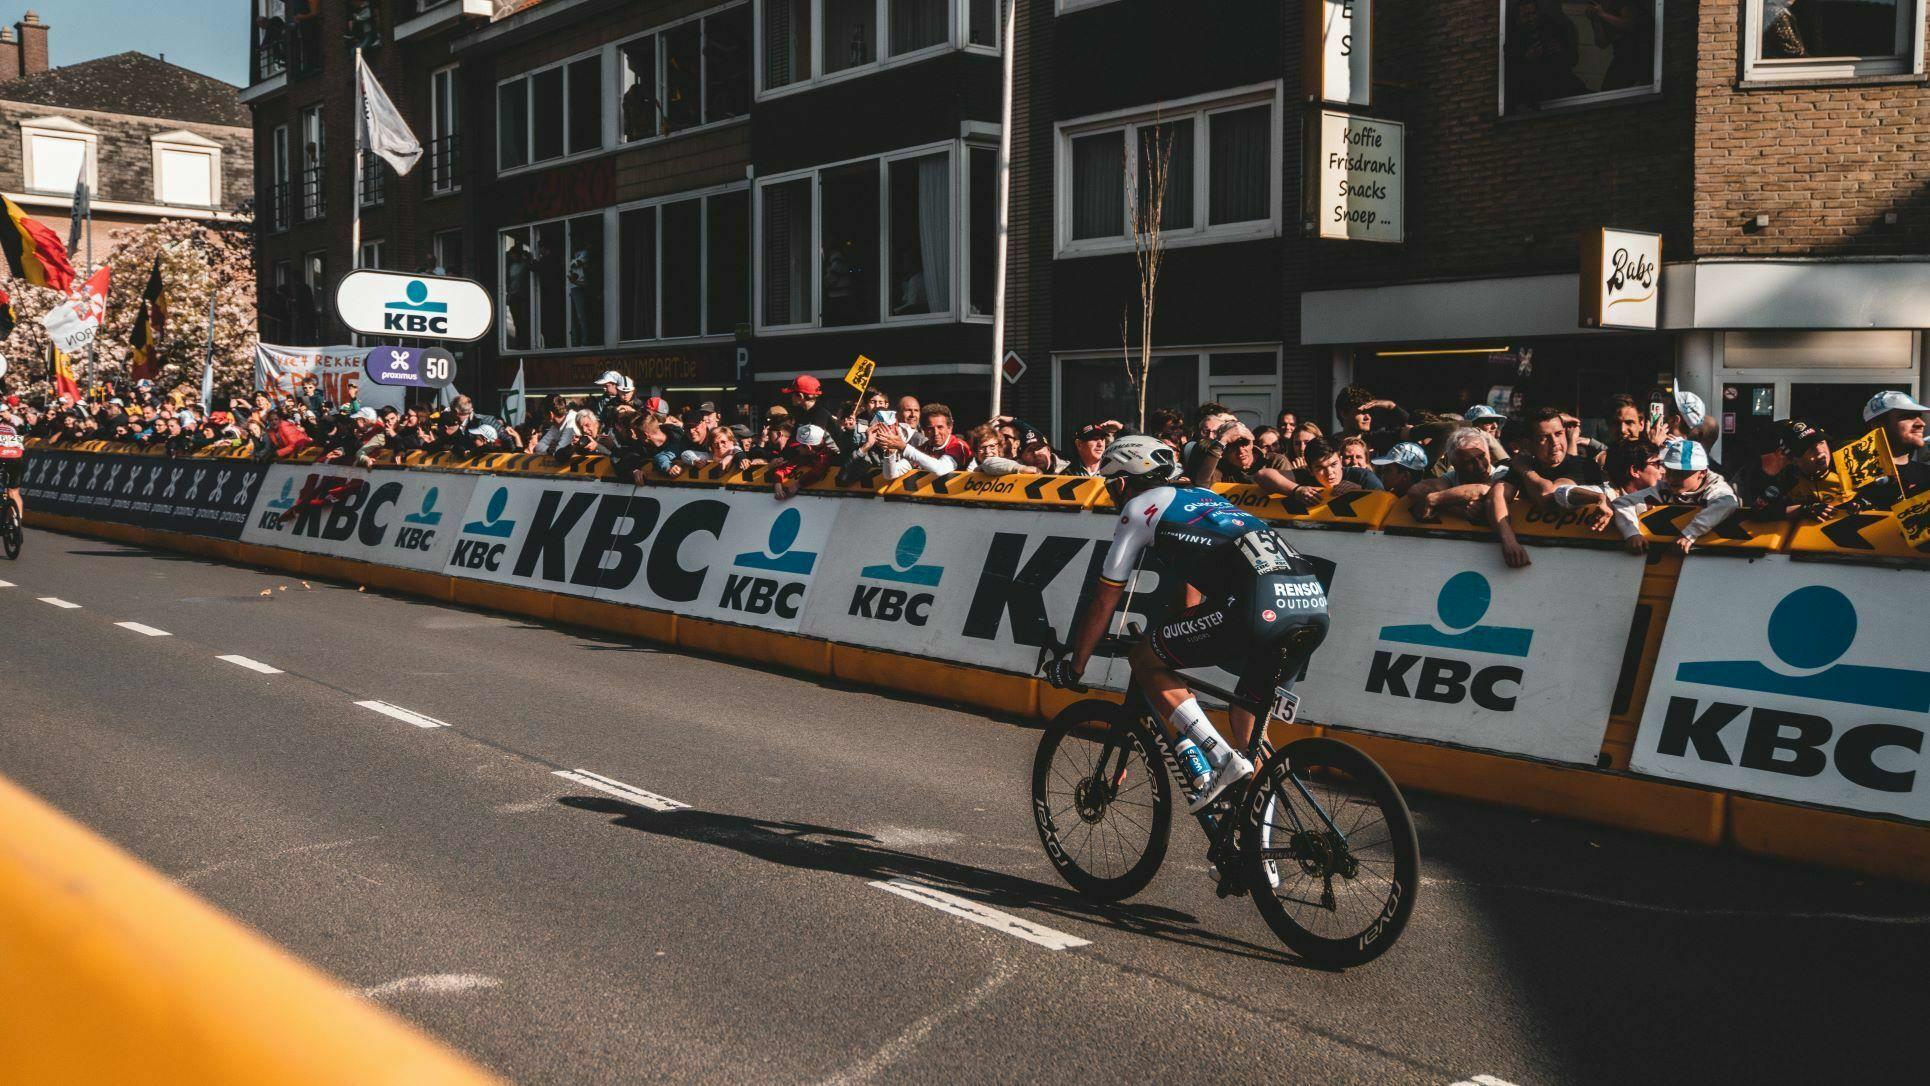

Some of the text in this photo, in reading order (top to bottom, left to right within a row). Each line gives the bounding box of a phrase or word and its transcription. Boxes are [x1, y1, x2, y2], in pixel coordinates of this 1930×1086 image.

[1343, 126, 1382, 148] Koffie
[1329, 152, 1396, 175] Frisdrank
[1339, 180, 1386, 200] Snacks
[1334, 205, 1376, 230] Snoep
[1607, 248, 1654, 295] Babs
[384, 312, 448, 334] KBC
[315, 354, 366, 368] REKKE
[426, 358, 449, 380] 50
[381, 371, 418, 381] proximus
[964, 476, 1015, 495] boplan
[291, 474, 404, 546] KBC
[394, 526, 436, 551] KBC
[1178, 532, 1212, 546] VINYL
[449, 489, 806, 619] KBC KBC KBC
[847, 583, 936, 627] KBC
[1364, 650, 1524, 713] KBC
[1272, 695, 1296, 721] 15
[1656, 696, 1925, 794] KBC
